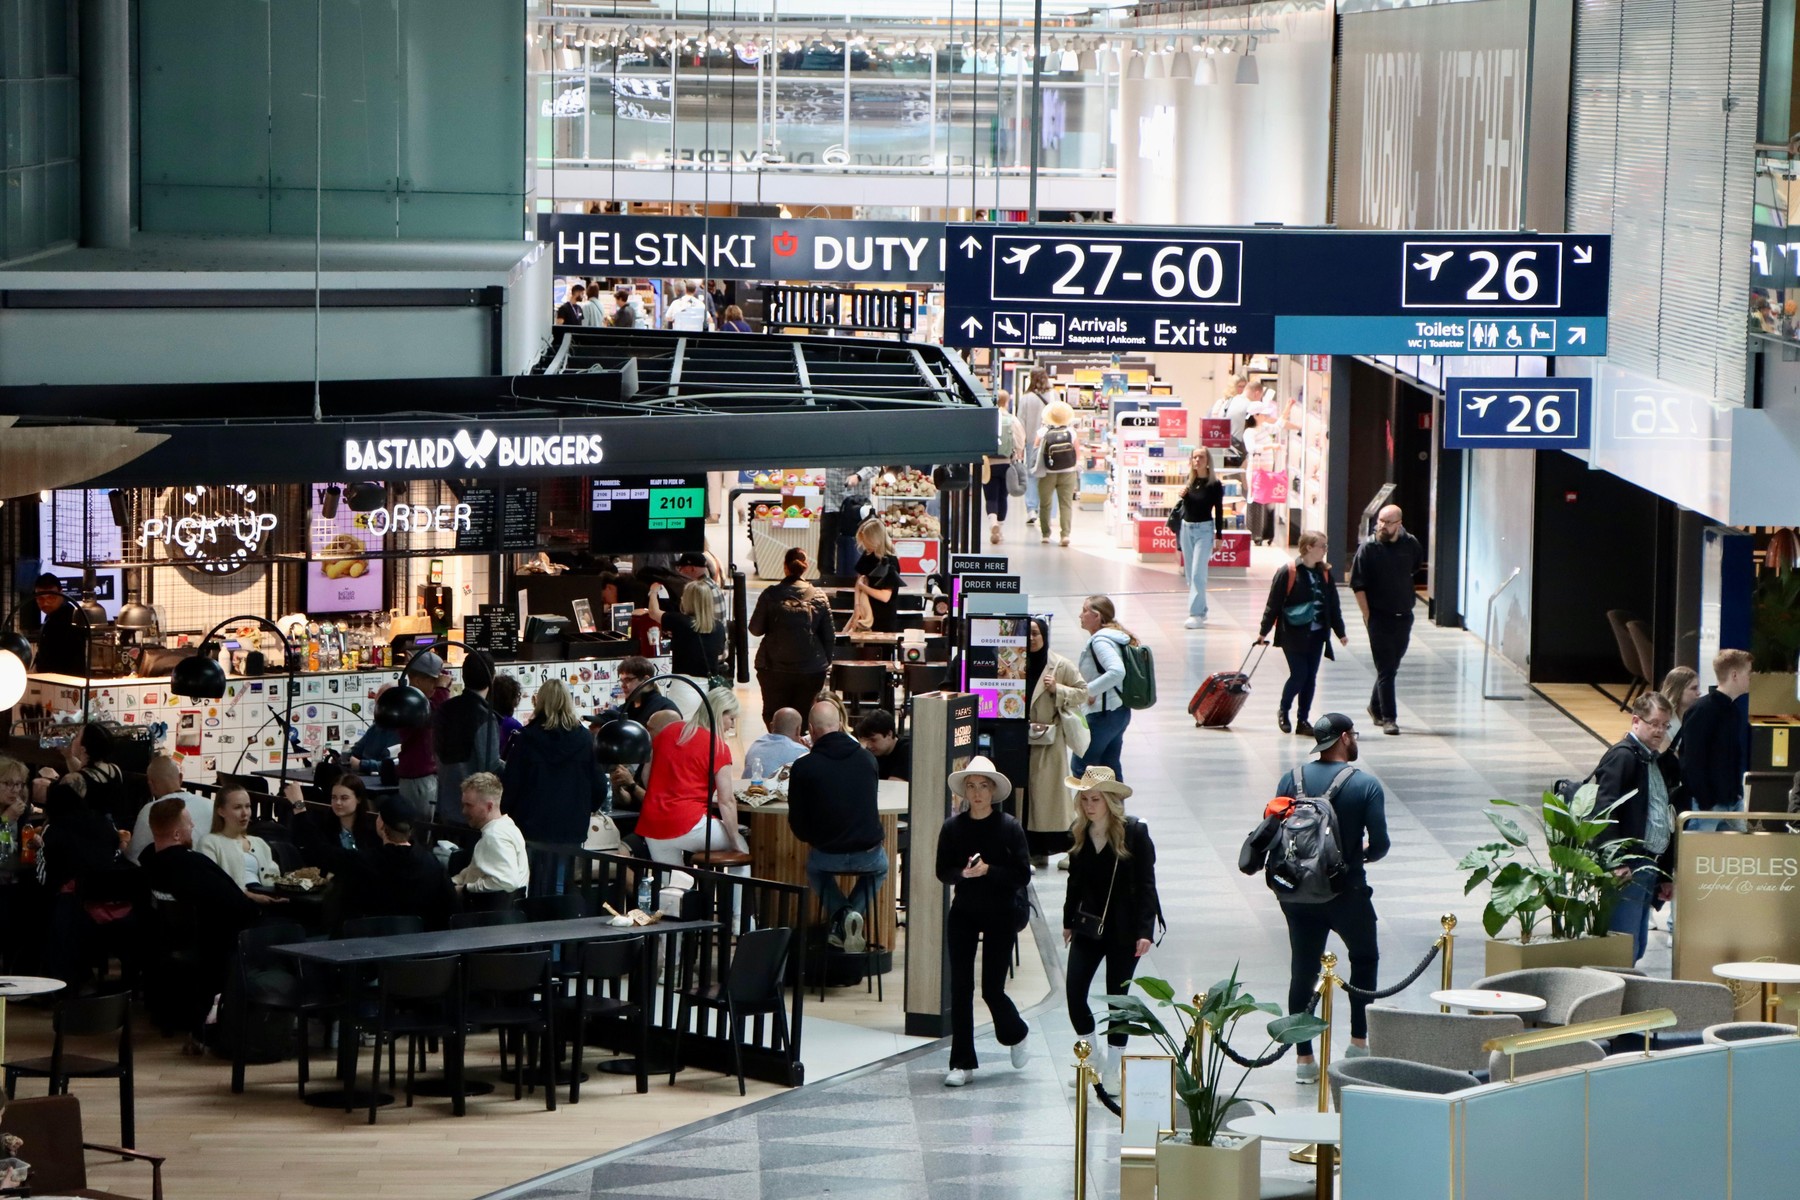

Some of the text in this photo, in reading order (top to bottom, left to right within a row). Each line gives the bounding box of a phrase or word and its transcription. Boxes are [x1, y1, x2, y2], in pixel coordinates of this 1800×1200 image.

[1359, 51, 1422, 230] NORDIC
[557, 230, 757, 268] HELSINKI
[813, 235, 930, 272] DUTY
[1051, 243, 1224, 299] 27-60
[1466, 250, 1539, 301] 26
[1068, 317, 1128, 332] Arrivals
[1154, 318, 1210, 346] Exit
[1214, 323, 1237, 334] Ulos
[1415, 322, 1465, 336] Toilets
[1068, 334, 1146, 345] Saapuvat Ankomst
[1214, 336, 1227, 346] Ut
[1429, 339, 1465, 348] Toaletter
[1506, 394, 1562, 433] 26
[346, 434, 603, 471] BASTARD BURGERS
[660, 496, 693, 510] 2101
[367, 503, 472, 537] ORDER
[142, 515, 218, 548] PICK
[233, 510, 278, 543] UP
[954, 561, 1006, 571] ORDER HERE
[964, 580, 1018, 589] ORDER HERE
[954, 706, 972, 717] FAFA'S
[954, 725, 972, 736] BASTARD
[953, 735, 972, 748] BURGERS
[1696, 856, 1798, 876] BUBBLES
[1696, 874, 1739, 901] seafood
[1756, 883, 1777, 891] wine
[1780, 877, 1796, 892] bar
